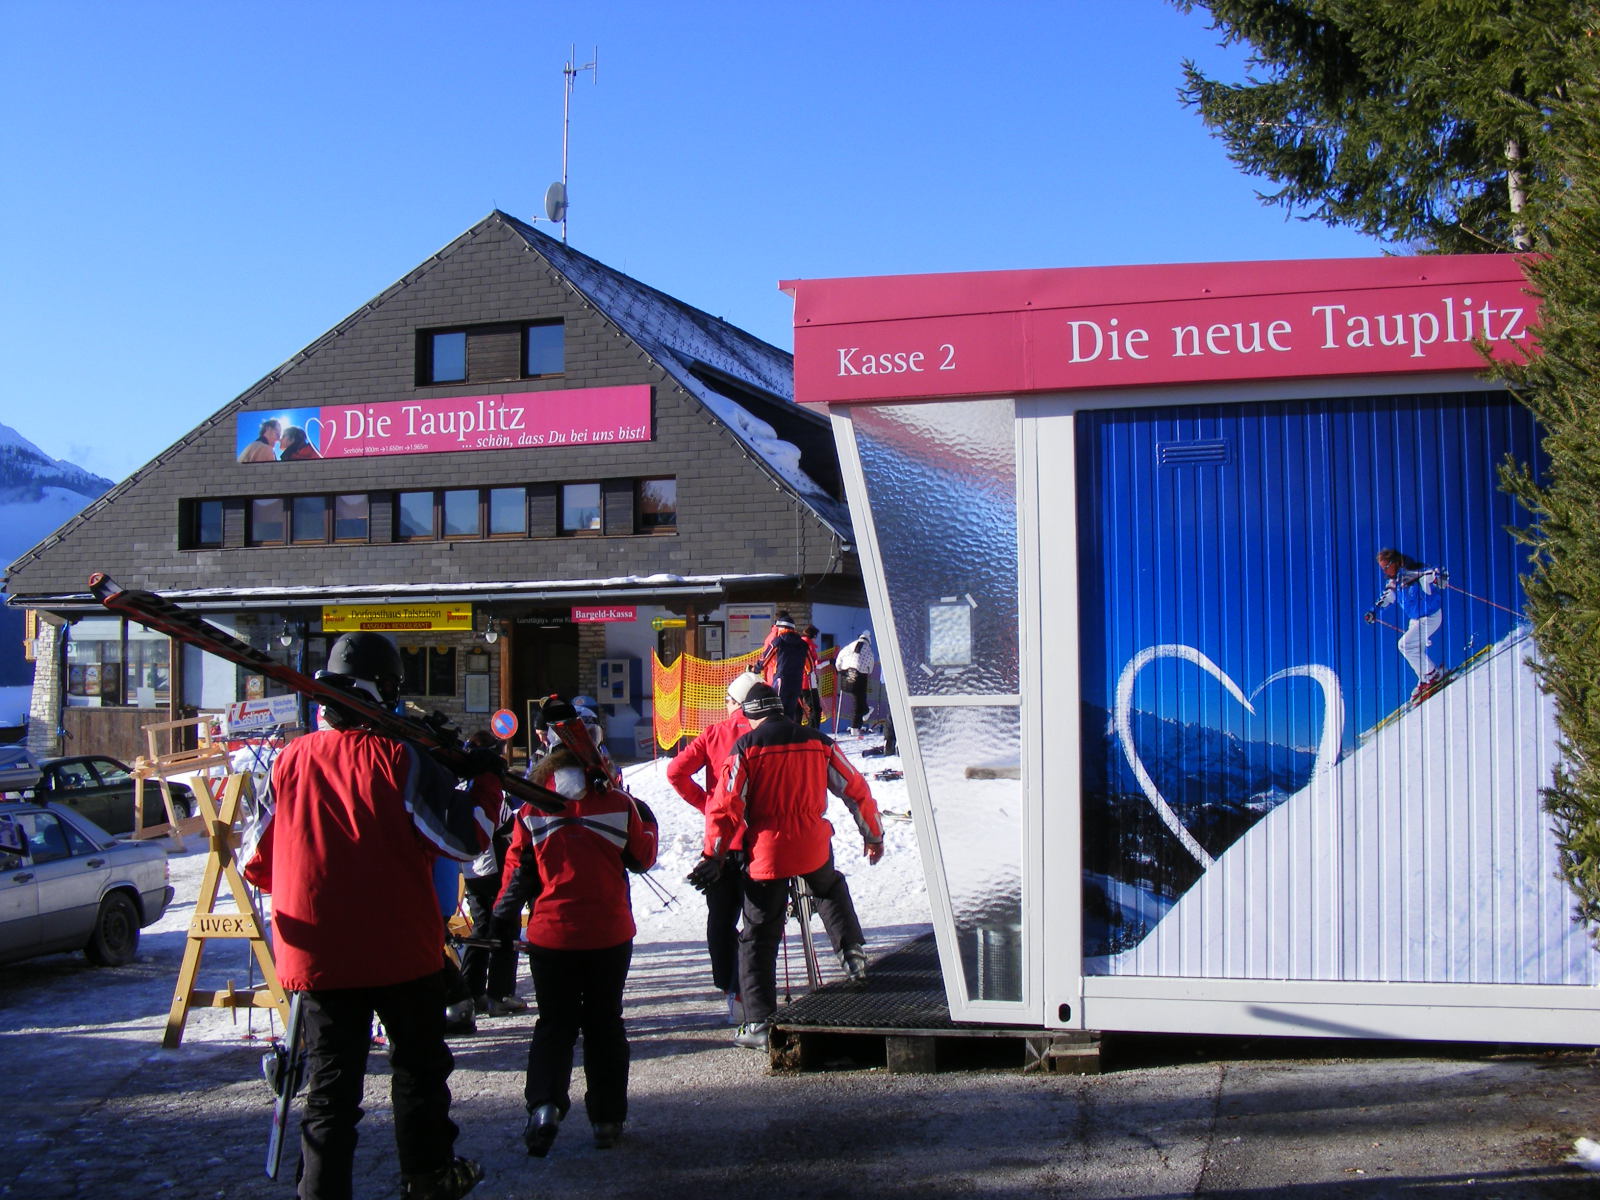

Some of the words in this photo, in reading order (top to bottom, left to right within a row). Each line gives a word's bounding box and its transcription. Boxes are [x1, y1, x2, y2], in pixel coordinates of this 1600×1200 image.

[1067, 317, 1149, 363] Die
[1171, 319, 1292, 358] neue
[1311, 297, 1527, 358] Tauplitz
[836, 347, 925, 376] Kasse
[939, 343, 956, 370] 2
[343, 408, 392, 440] Die
[401, 400, 526, 442] Tauplitz
[476, 433, 513, 448] schön,
[518, 431, 545, 446] dass
[548, 430, 566, 444] Du
[570, 428, 588, 442] bei
[592, 429, 614, 441] uns
[618, 425, 646, 439] bist!
[351, 608, 401, 621] Dorfgasthaus
[403, 607, 442, 619] Talstation
[575, 608, 633, 621] Bargeld-Kassa
[200, 918, 244, 933] uvex
